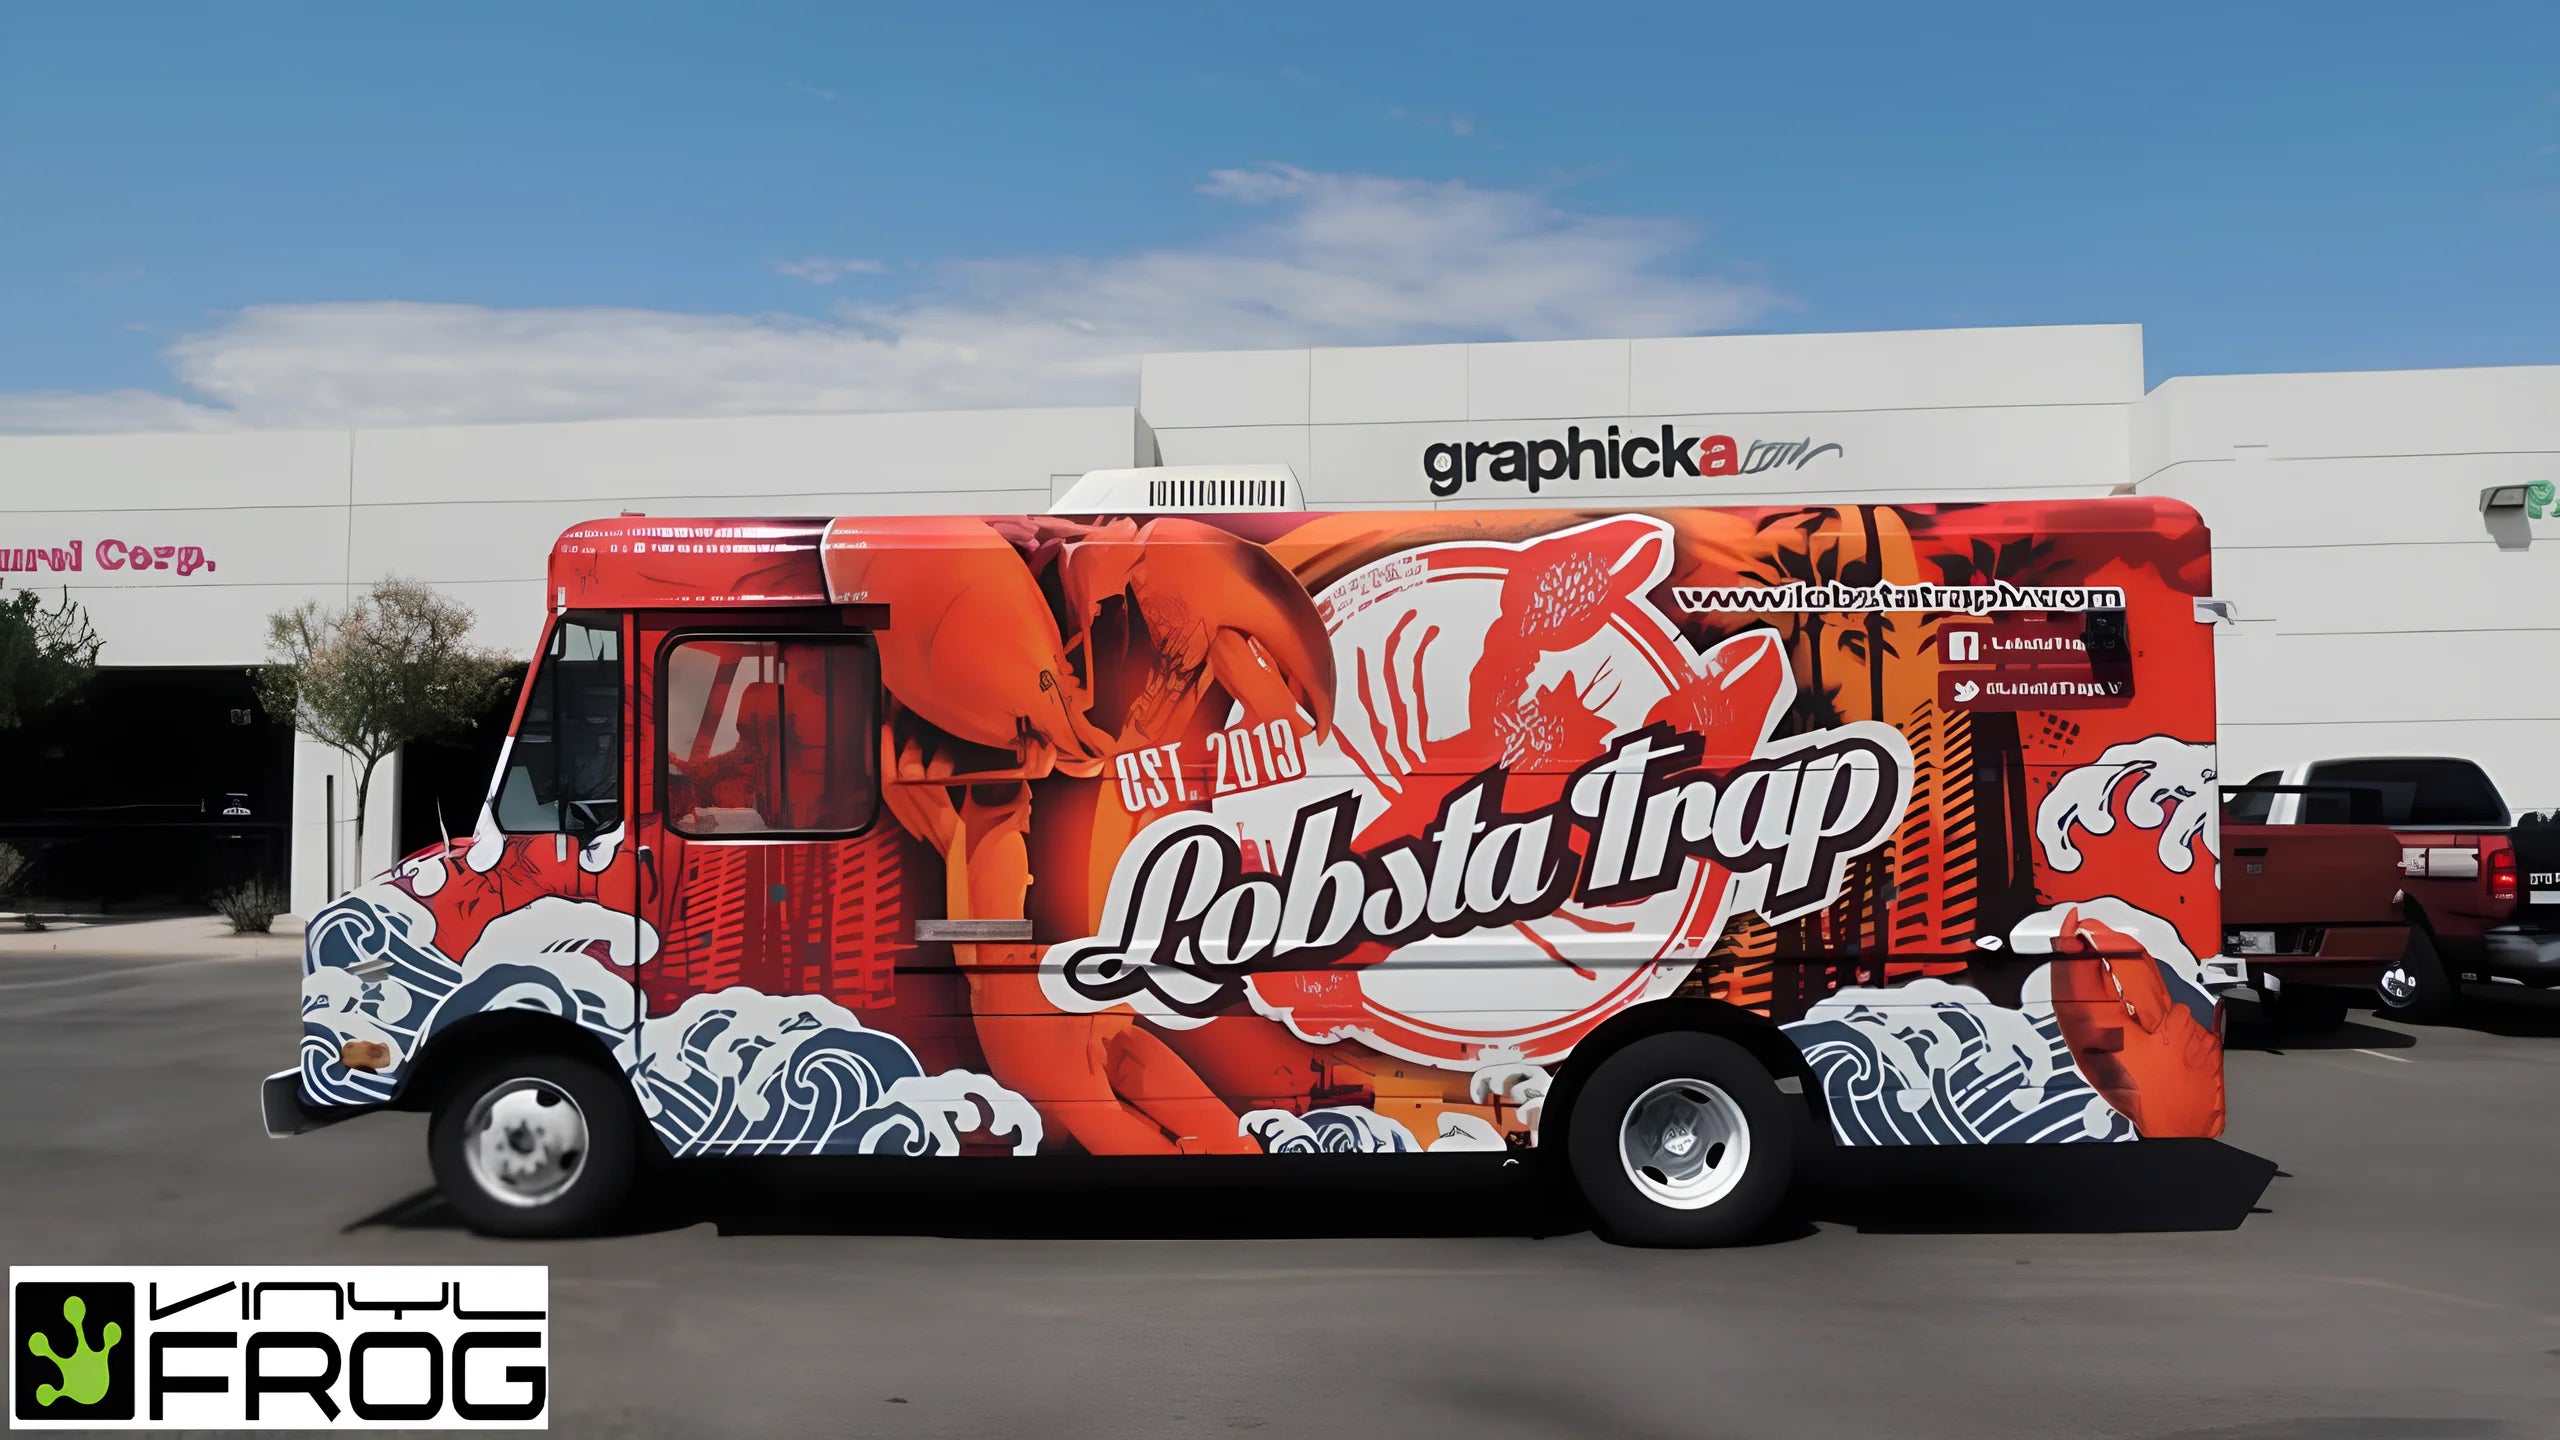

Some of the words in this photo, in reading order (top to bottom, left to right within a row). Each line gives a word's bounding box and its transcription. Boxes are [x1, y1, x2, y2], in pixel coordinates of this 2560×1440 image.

[96, 538, 216, 577] Corp.
[1206, 718, 1302, 794] 2013
[1063, 782, 1562, 1008] Lobsta
[1570, 735, 1882, 898] Trap
